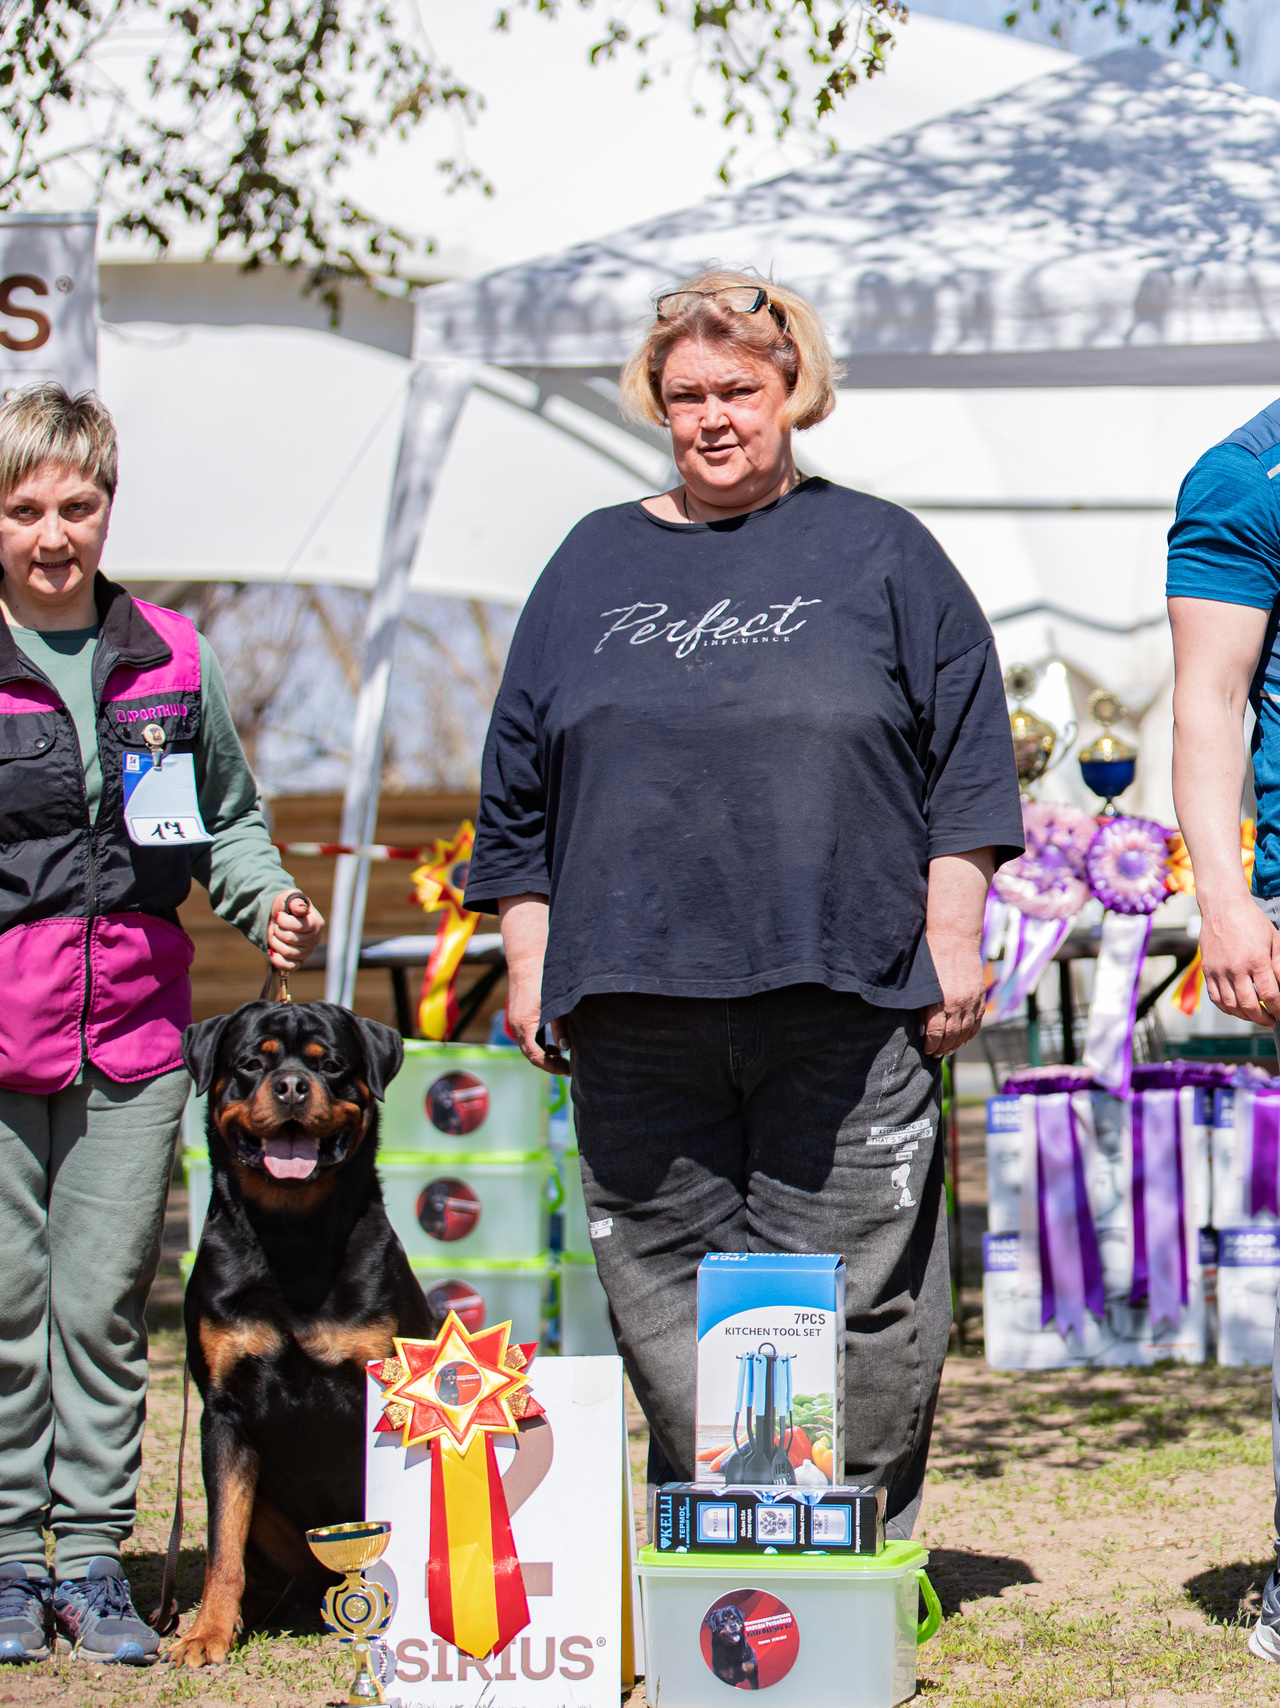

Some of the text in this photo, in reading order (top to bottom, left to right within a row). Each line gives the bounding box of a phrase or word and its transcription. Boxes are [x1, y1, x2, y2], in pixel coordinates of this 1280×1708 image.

[594, 595, 822, 658] Perfect
[703, 636, 790, 646] INFLUENCE
[151, 821, 186, 840] 17
[794, 1313, 826, 1325] 7PCS
[725, 1327, 822, 1337] KITCHEN TOOL SET
[660, 1495, 673, 1538] KELLI
[395, 1634, 595, 1683] SIRIUS
